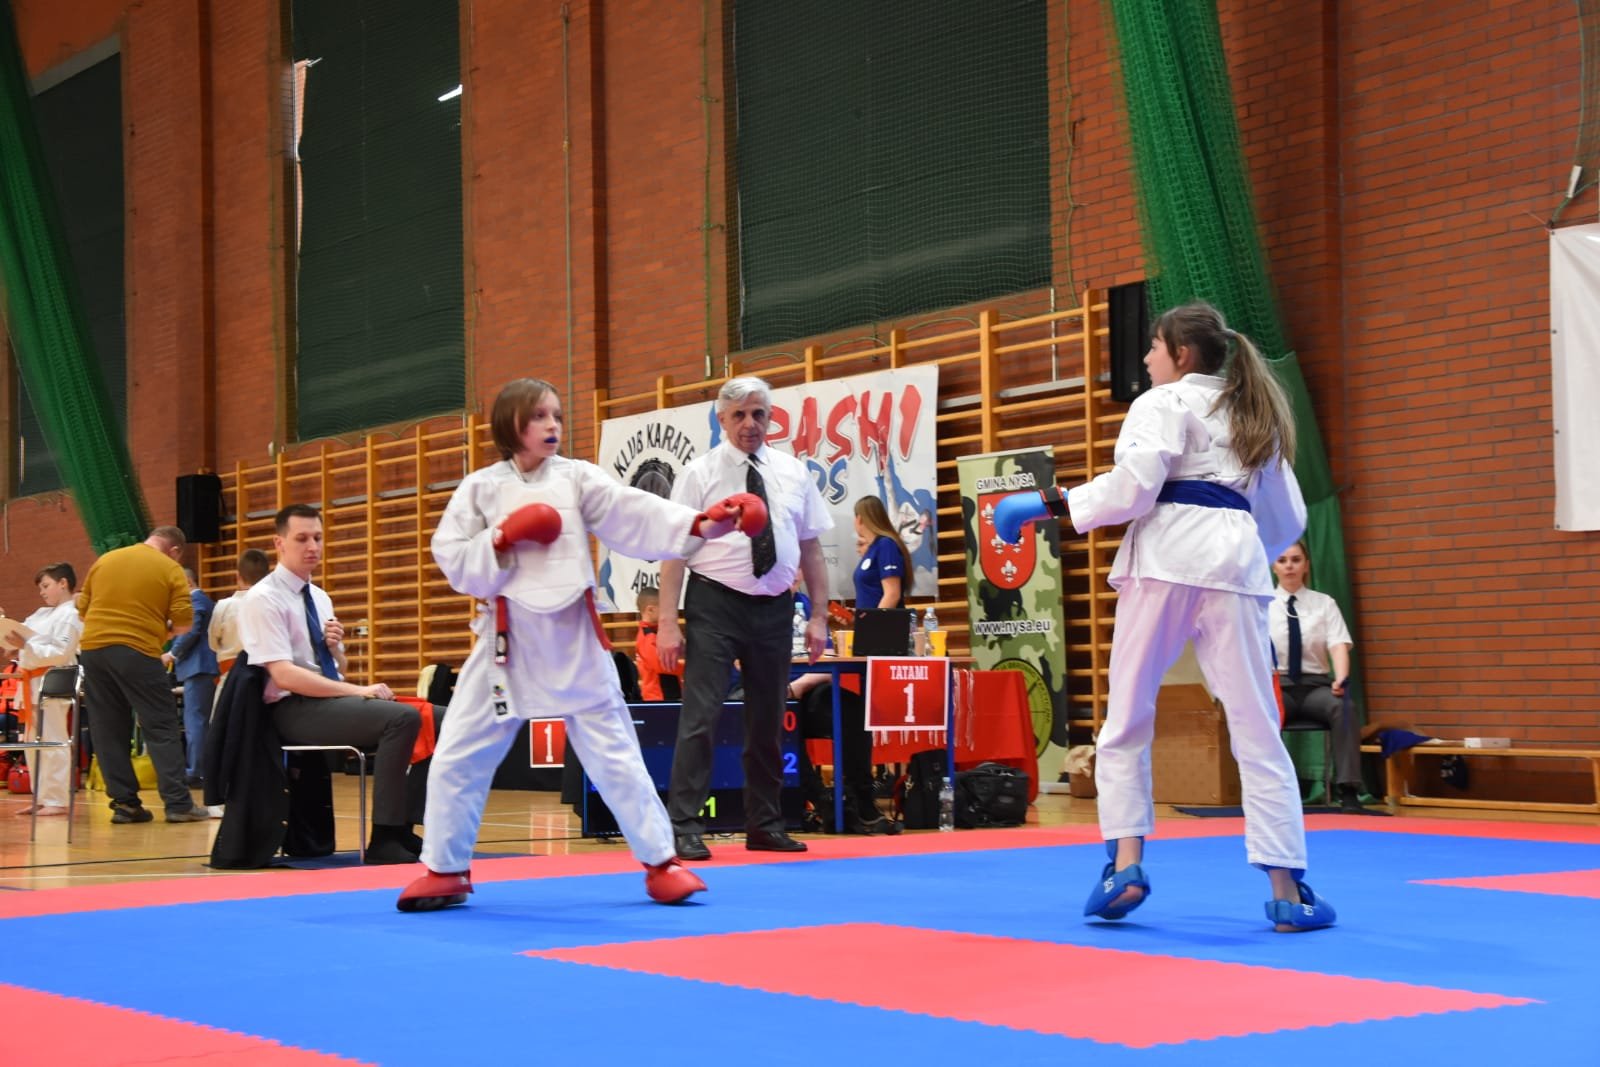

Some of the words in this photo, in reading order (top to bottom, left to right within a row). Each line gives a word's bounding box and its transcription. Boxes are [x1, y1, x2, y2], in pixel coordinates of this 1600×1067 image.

[613, 429, 644, 478] KLUB
[646, 422, 695, 466] KARATE
[976, 476, 1006, 490] GMINA
[1008, 473, 1035, 488] NYSA
[975, 620, 1050, 636] www.nysa.eu
[889, 665, 929, 680] TATAMI
[903, 682, 916, 723] 1
[783, 711, 797, 731] 0
[544, 723, 554, 763] 1
[783, 752, 798, 774] 2
